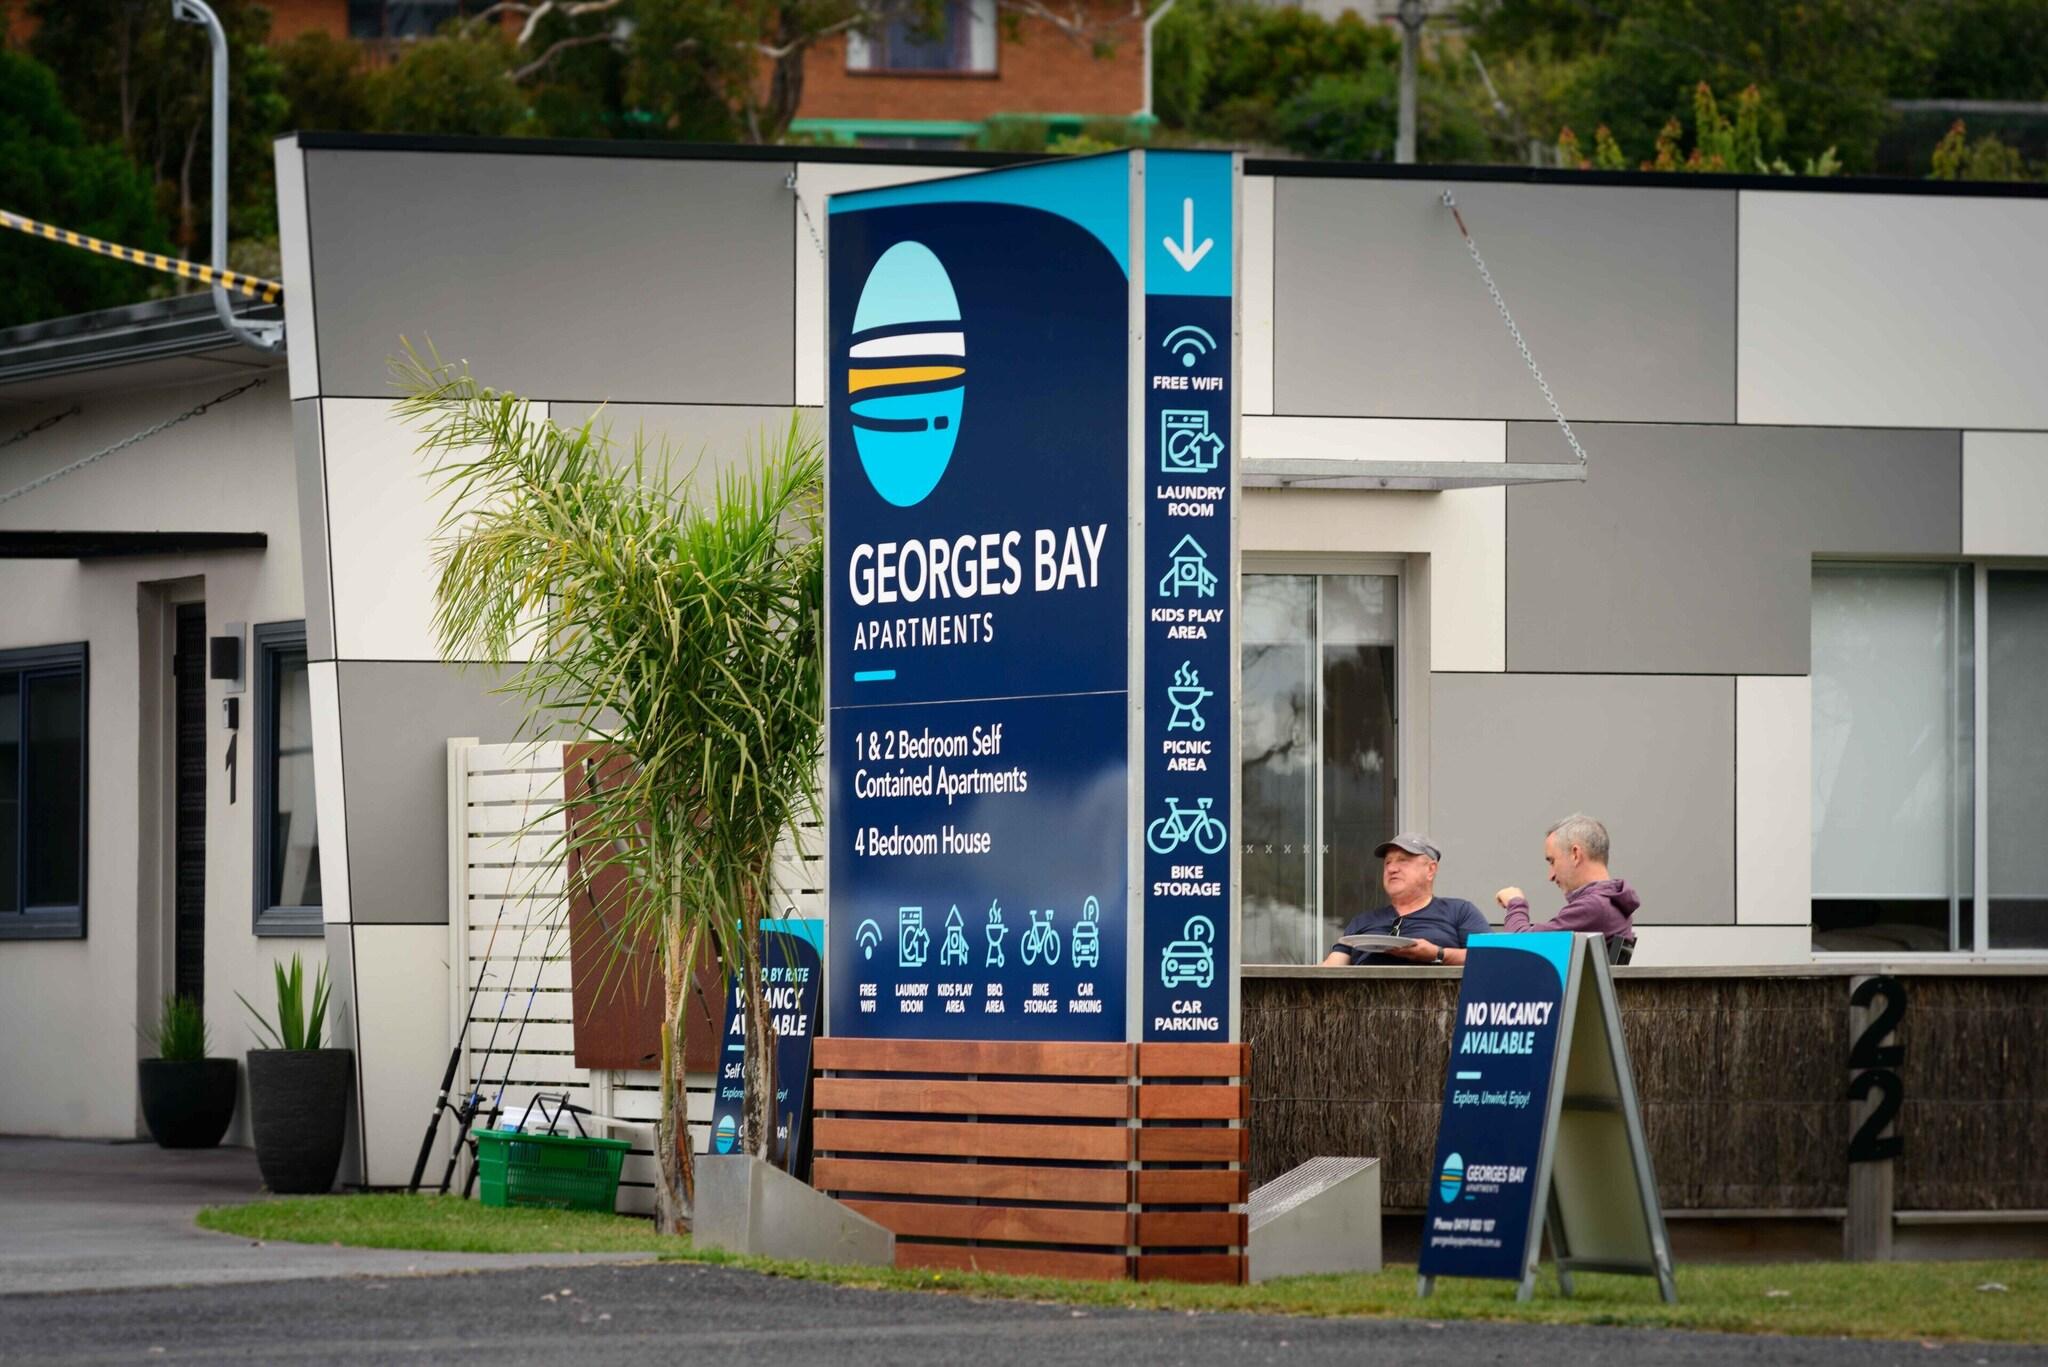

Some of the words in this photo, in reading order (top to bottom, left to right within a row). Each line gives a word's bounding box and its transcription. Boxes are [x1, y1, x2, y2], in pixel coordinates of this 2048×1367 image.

[1153, 376, 1189, 390] FREE
[1192, 377, 1223, 391] WIFI
[1157, 485, 1226, 500] LAUNDRY
[1168, 503, 1214, 517] ROOM
[849, 530, 1022, 606] GEORGES
[1035, 523, 1108, 592] BAY
[1151, 608, 1185, 622] KIDS
[1187, 609, 1224, 622] PLAY
[854, 612, 993, 651] APARTMENTS
[1167, 626, 1207, 639] AREA
[855, 732, 863, 761] 1
[868, 731, 881, 760] &
[884, 730, 895, 759] 2
[899, 727, 968, 759] Bedroom
[972, 723, 1002, 757] Self
[1163, 741, 1212, 755] PICNIC
[1167, 757, 1207, 771] AREA
[855, 765, 932, 798] Contained
[936, 766, 1027, 805] Apartments
[855, 827, 865, 857] 4
[869, 825, 938, 856] Bedroom
[942, 825, 991, 854] House
[1171, 865, 1204, 879] BIKE
[1153, 883, 1221, 896] STORAGE
[770, 968, 784, 982] BY
[859, 984, 877, 996] FREE
[895, 984, 929, 996] LAUNDRY
[937, 984, 954, 996] KIDS
[955, 984, 973, 996] PLAY
[987, 984, 1003, 997] BBQ
[1032, 983, 1050, 996] BIKE
[1077, 983, 1094, 996] CAR
[735, 987, 804, 1010] VANCY
[860, 1000, 876, 1013] WIFI
[900, 1000, 924, 1013] ROOM
[945, 1000, 965, 1013] AREA
[985, 1000, 1005, 1013] AREA
[1023, 1000, 1058, 1013] STORAGE
[1069, 1000, 1102, 1013] PARKING
[1171, 1000, 1202, 1014] CAR
[1465, 1002, 1488, 1025] NO
[1490, 1002, 1553, 1026] VACANCY
[729, 1014, 807, 1036] AABLE
[1155, 1017, 1219, 1031] PARKING
[1460, 1031, 1535, 1054] AVAILABLE
[724, 1063, 741, 1079] Self
[1848, 977, 1908, 1164] 22
[1467, 1164, 1508, 1183] GEORGES
[1508, 1166, 1528, 1183] BAY
